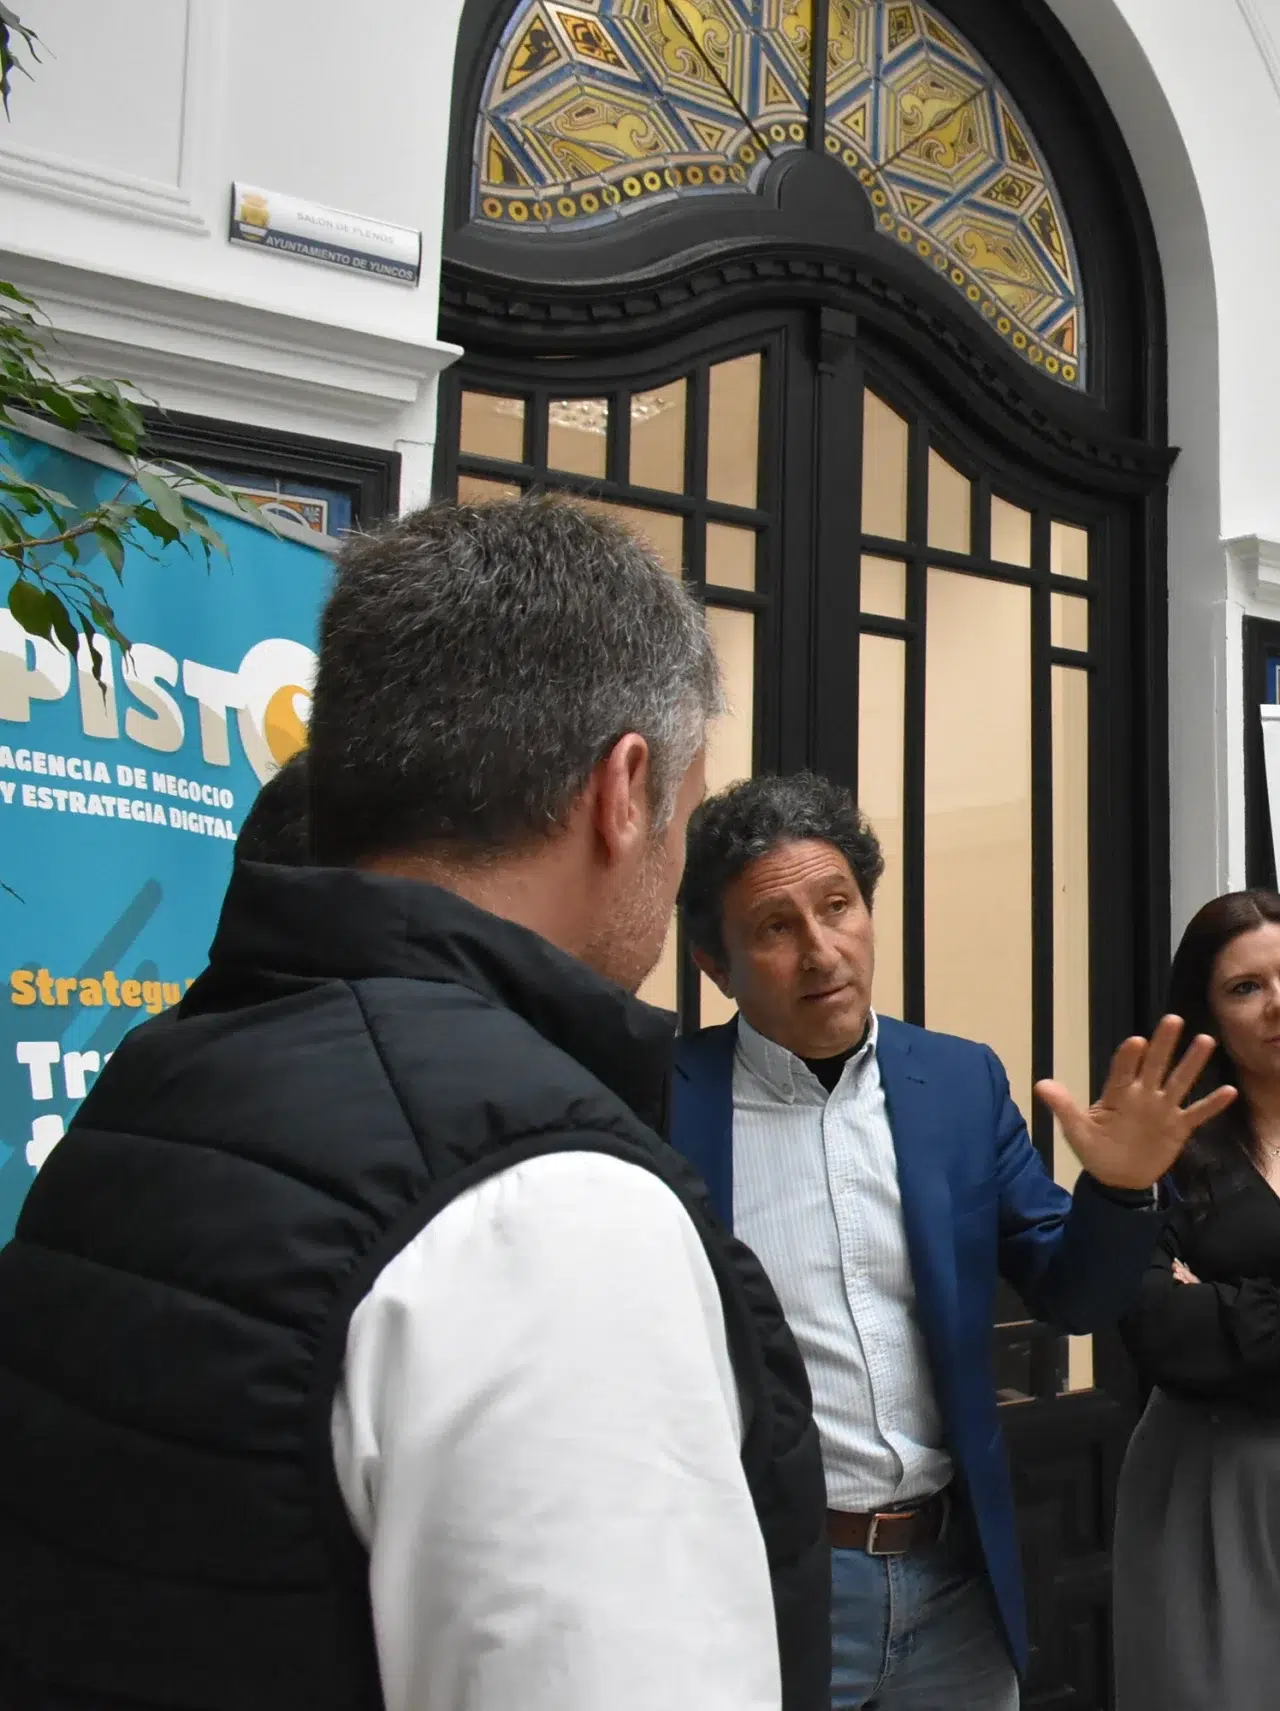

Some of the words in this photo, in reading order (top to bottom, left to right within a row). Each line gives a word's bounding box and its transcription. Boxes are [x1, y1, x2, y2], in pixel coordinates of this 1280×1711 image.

[266, 236, 350, 264] AYUNTAMIENTO
[352, 257, 367, 268] DE
[369, 260, 414, 280] YUNCOS
[0, 746, 111, 784] AGENCIA
[117, 765, 148, 790] DE
[152, 772, 234, 809] NEGOCIO
[0, 782, 16, 804] Y
[22, 785, 167, 826] ESTRATEGIA
[170, 808, 237, 840] DIGITAL
[16, 1041, 115, 1100] Tr
